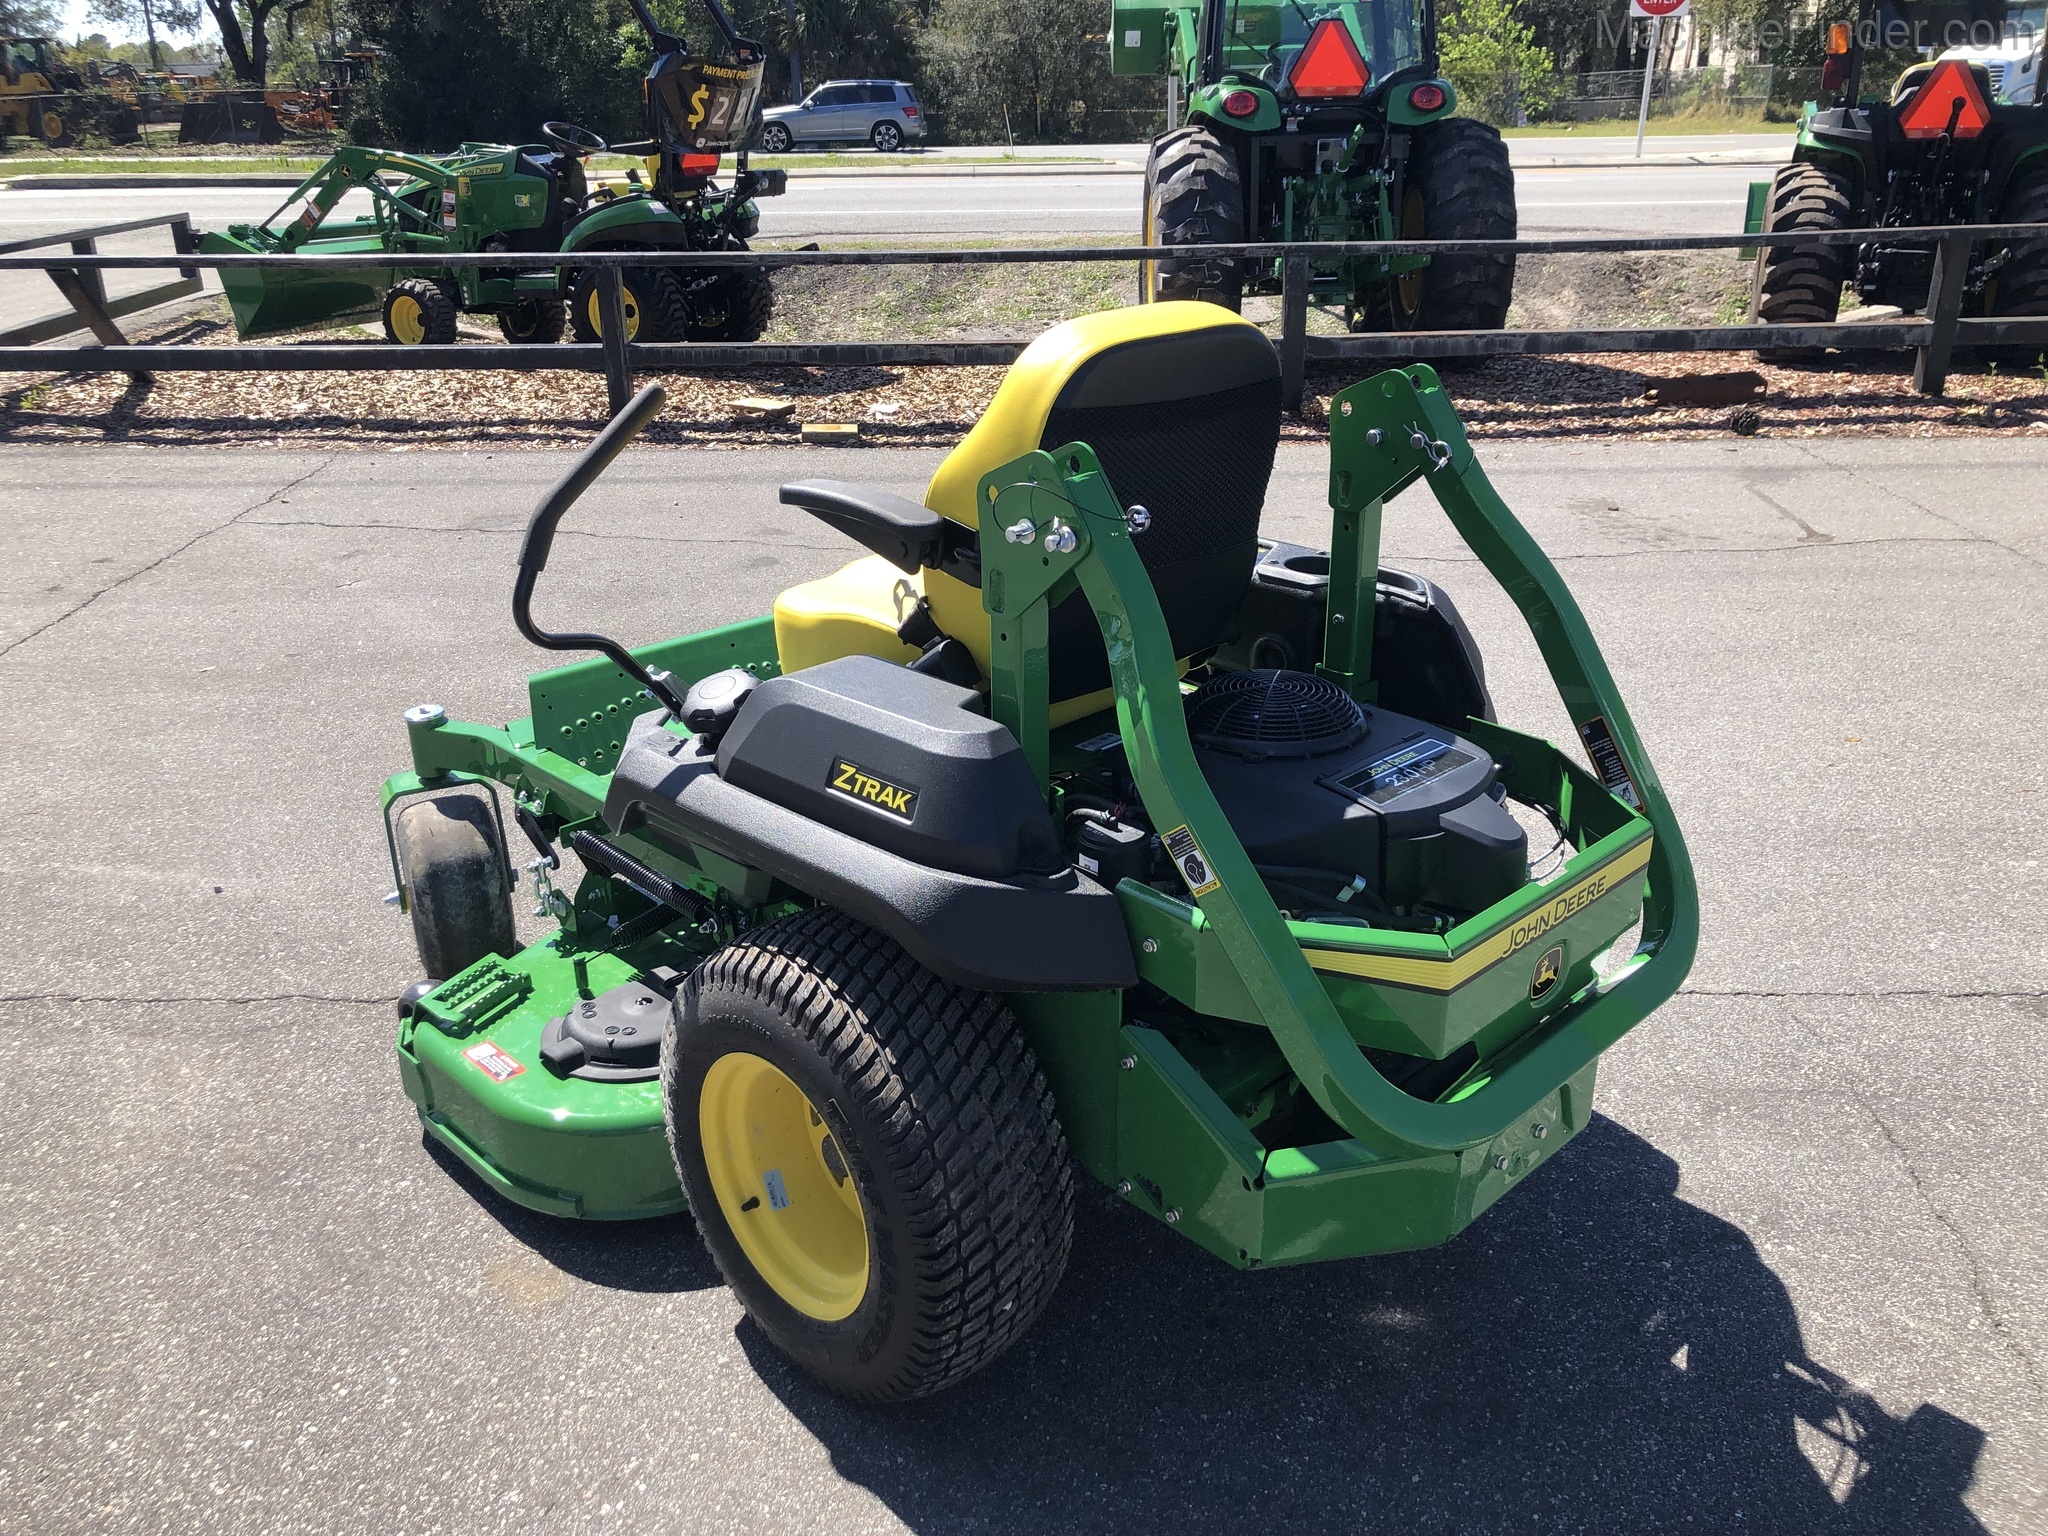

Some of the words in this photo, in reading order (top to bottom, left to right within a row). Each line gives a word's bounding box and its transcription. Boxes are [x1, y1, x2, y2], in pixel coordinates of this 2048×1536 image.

[702, 64, 737, 79] PAYMENT
[474, 165, 499, 176] DEERE
[1367, 762, 1393, 777] JOHN
[1389, 751, 1420, 767] DEERE
[1385, 766, 1421, 787] 23.0
[1418, 759, 1437, 775] HP
[833, 763, 912, 813] ZTRAK
[1503, 911, 1551, 955] JOHN
[1554, 875, 1607, 923] DEERE
